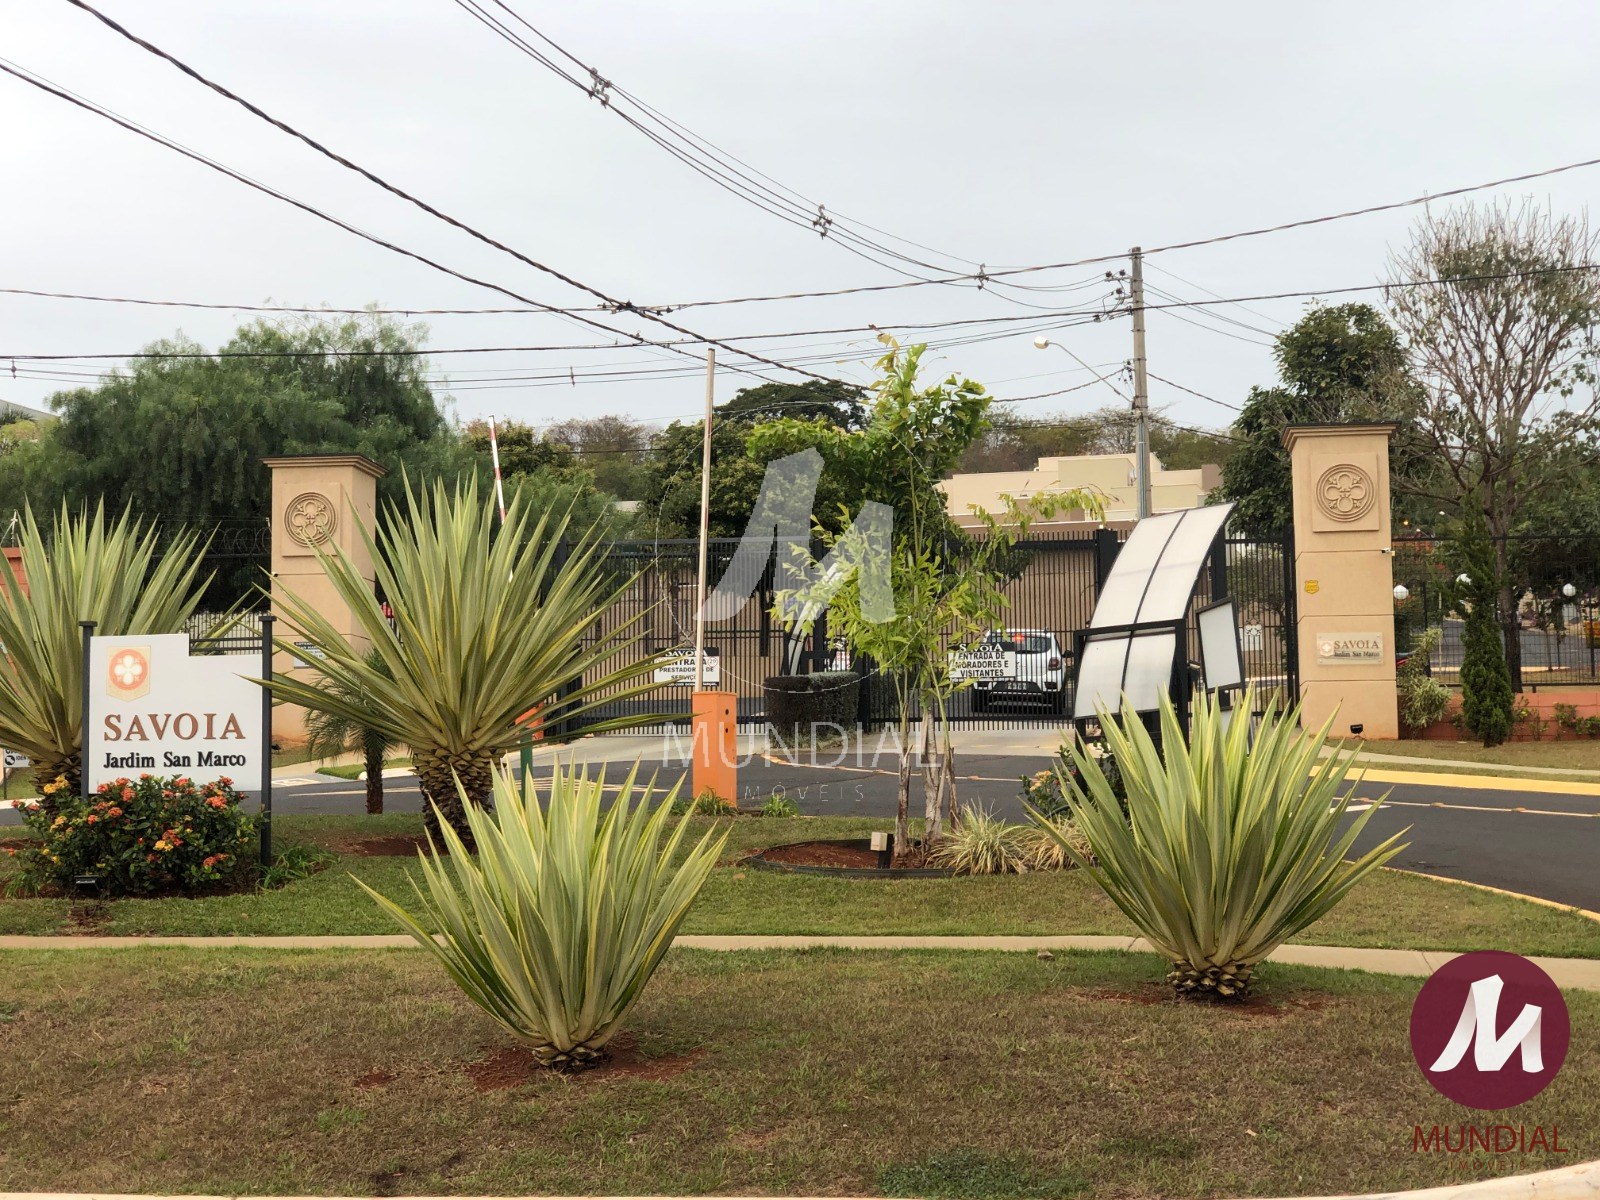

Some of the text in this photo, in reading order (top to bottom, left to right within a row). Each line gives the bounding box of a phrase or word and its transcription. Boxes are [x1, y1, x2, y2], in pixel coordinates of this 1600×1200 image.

[960, 643, 1003, 652] SVOIA
[1334, 640, 1379, 649] SAVOIA
[995, 652, 1005, 660] DE
[955, 660, 1009, 669] MORADORES E
[960, 669, 1004, 677] VISITANTES
[104, 713, 246, 742] SAVOIA
[103, 751, 246, 768] Jardim San Marco
